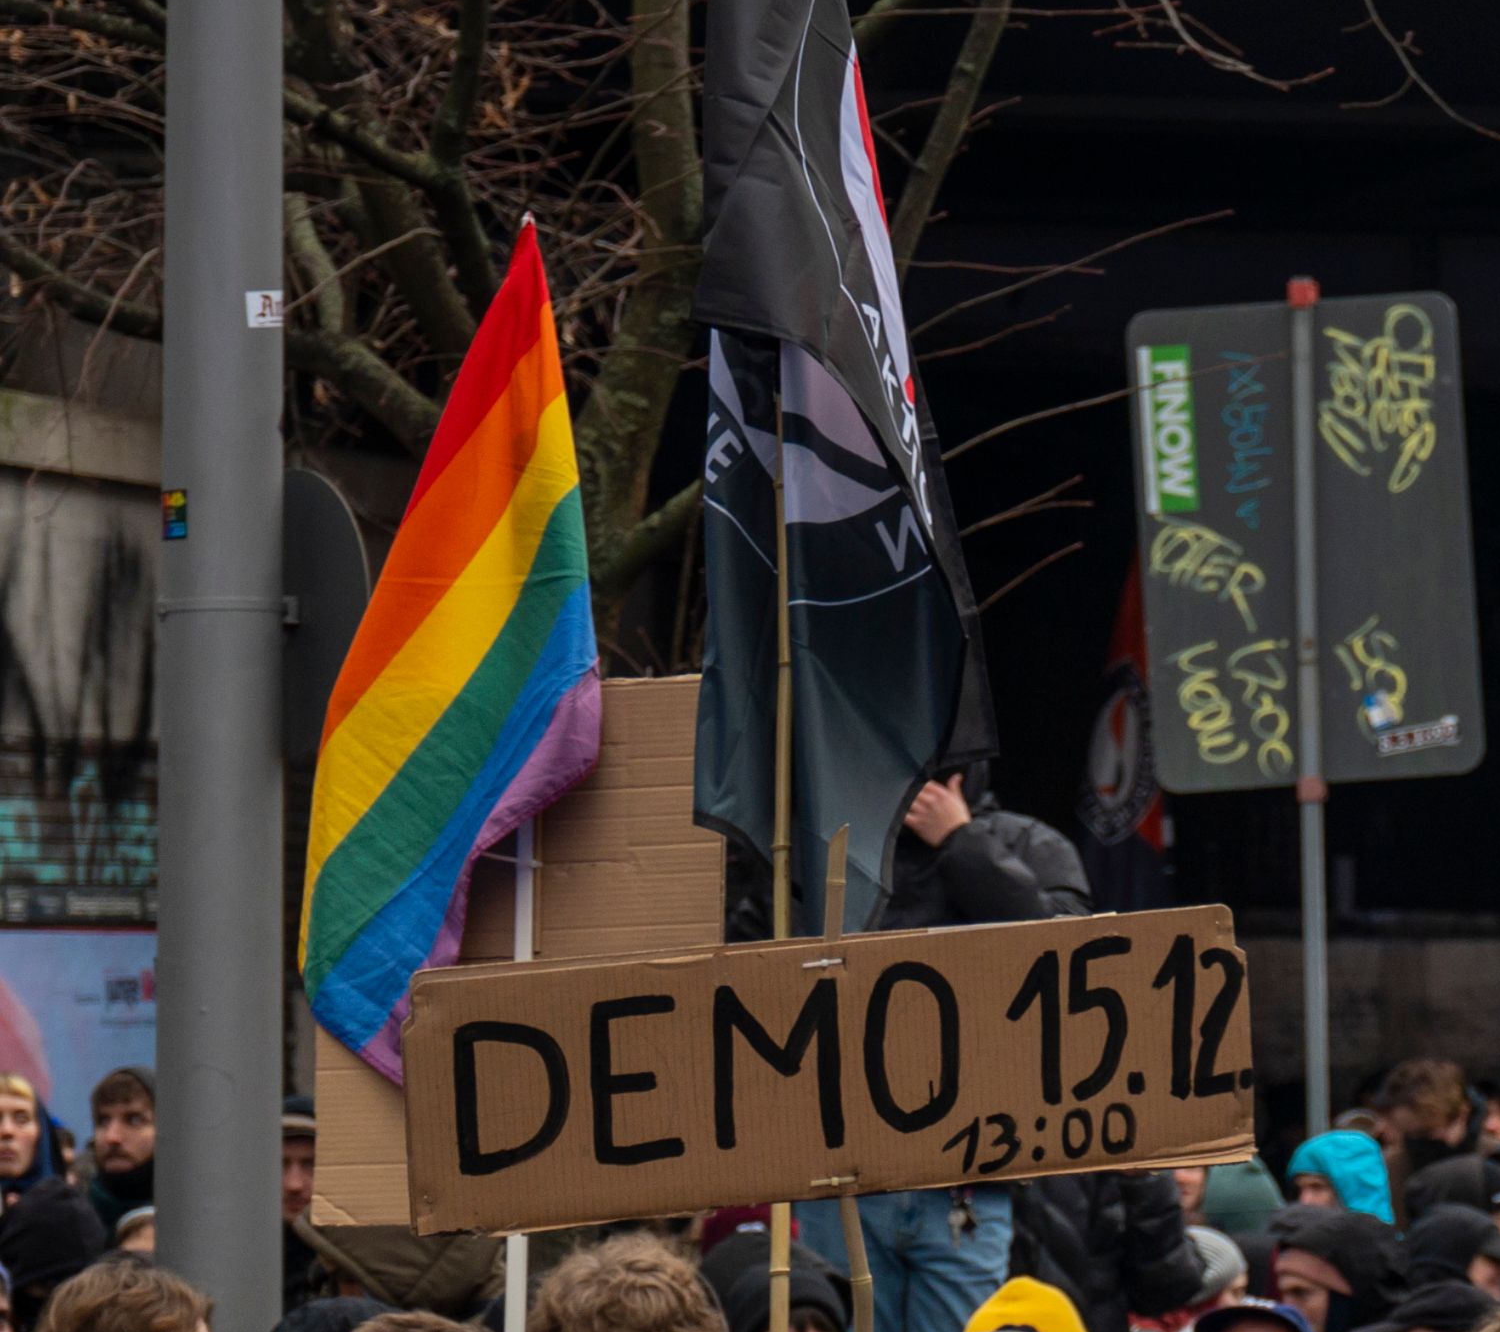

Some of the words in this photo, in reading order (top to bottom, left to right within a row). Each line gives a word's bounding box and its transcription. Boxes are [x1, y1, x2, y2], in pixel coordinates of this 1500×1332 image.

[1152, 359, 1194, 498] FINOW
[454, 961, 960, 1176] DEMO
[943, 1101, 1136, 1174] 13:00
